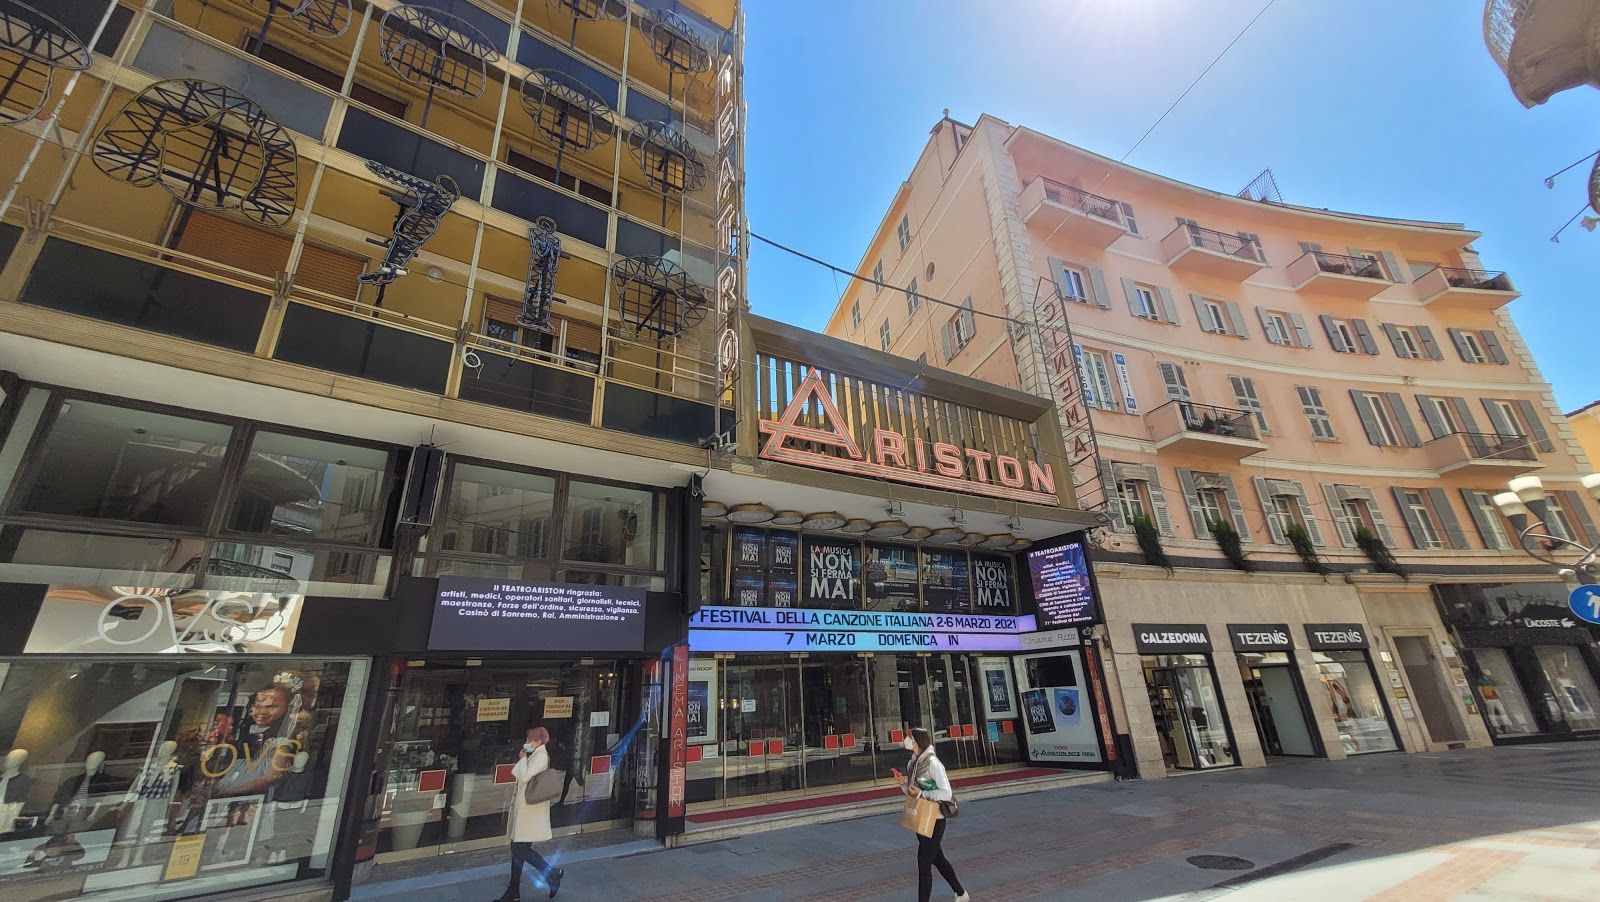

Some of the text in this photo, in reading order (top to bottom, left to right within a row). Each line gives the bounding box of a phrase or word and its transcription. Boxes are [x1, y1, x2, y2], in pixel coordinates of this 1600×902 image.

[717, 54, 739, 375] TEATRO
[759, 366, 1057, 496] ARISTON
[810, 545, 852, 556] LA MUSICA
[1034, 542, 1079, 557] TEATROARISTON
[811, 553, 852, 571] NON
[811, 568, 853, 580] SI FERMA
[976, 566, 1007, 582] NON
[501, 584, 565, 594] TEATROARISTON
[566, 588, 602, 597] ringrazia:
[810, 577, 854, 600] MAI
[977, 580, 1007, 590] SI FERMA
[440, 590, 641, 607] artisti, medici, operatori sanitari, giornalisti, tecnici,
[978, 588, 1010, 607] MAI
[441, 600, 640, 615] maestranze, Forze dell'ordine, sicurezza, vigilanza,
[458, 608, 489, 617] Casinò
[501, 610, 540, 619] Sanremo,
[542, 611, 557, 620] Rai,
[558, 612, 619, 621] Amministrazione
[98, 594, 249, 646] OVS
[700, 609, 771, 624] FESTIVAL
[776, 611, 820, 625] DELLA
[823, 613, 882, 627] CANZONE
[885, 614, 935, 628] ITALIANA
[955, 617, 991, 629] MARZO
[994, 618, 1017, 630] 2021
[1525, 619, 1560, 628] LACOSTE
[785, 632, 959, 646] 7 MARZO DOMENICA IN
[1141, 632, 1208, 645] CALZEDONIA
[687, 703, 701, 711] ON
[671, 727, 684, 808] ARISTON
